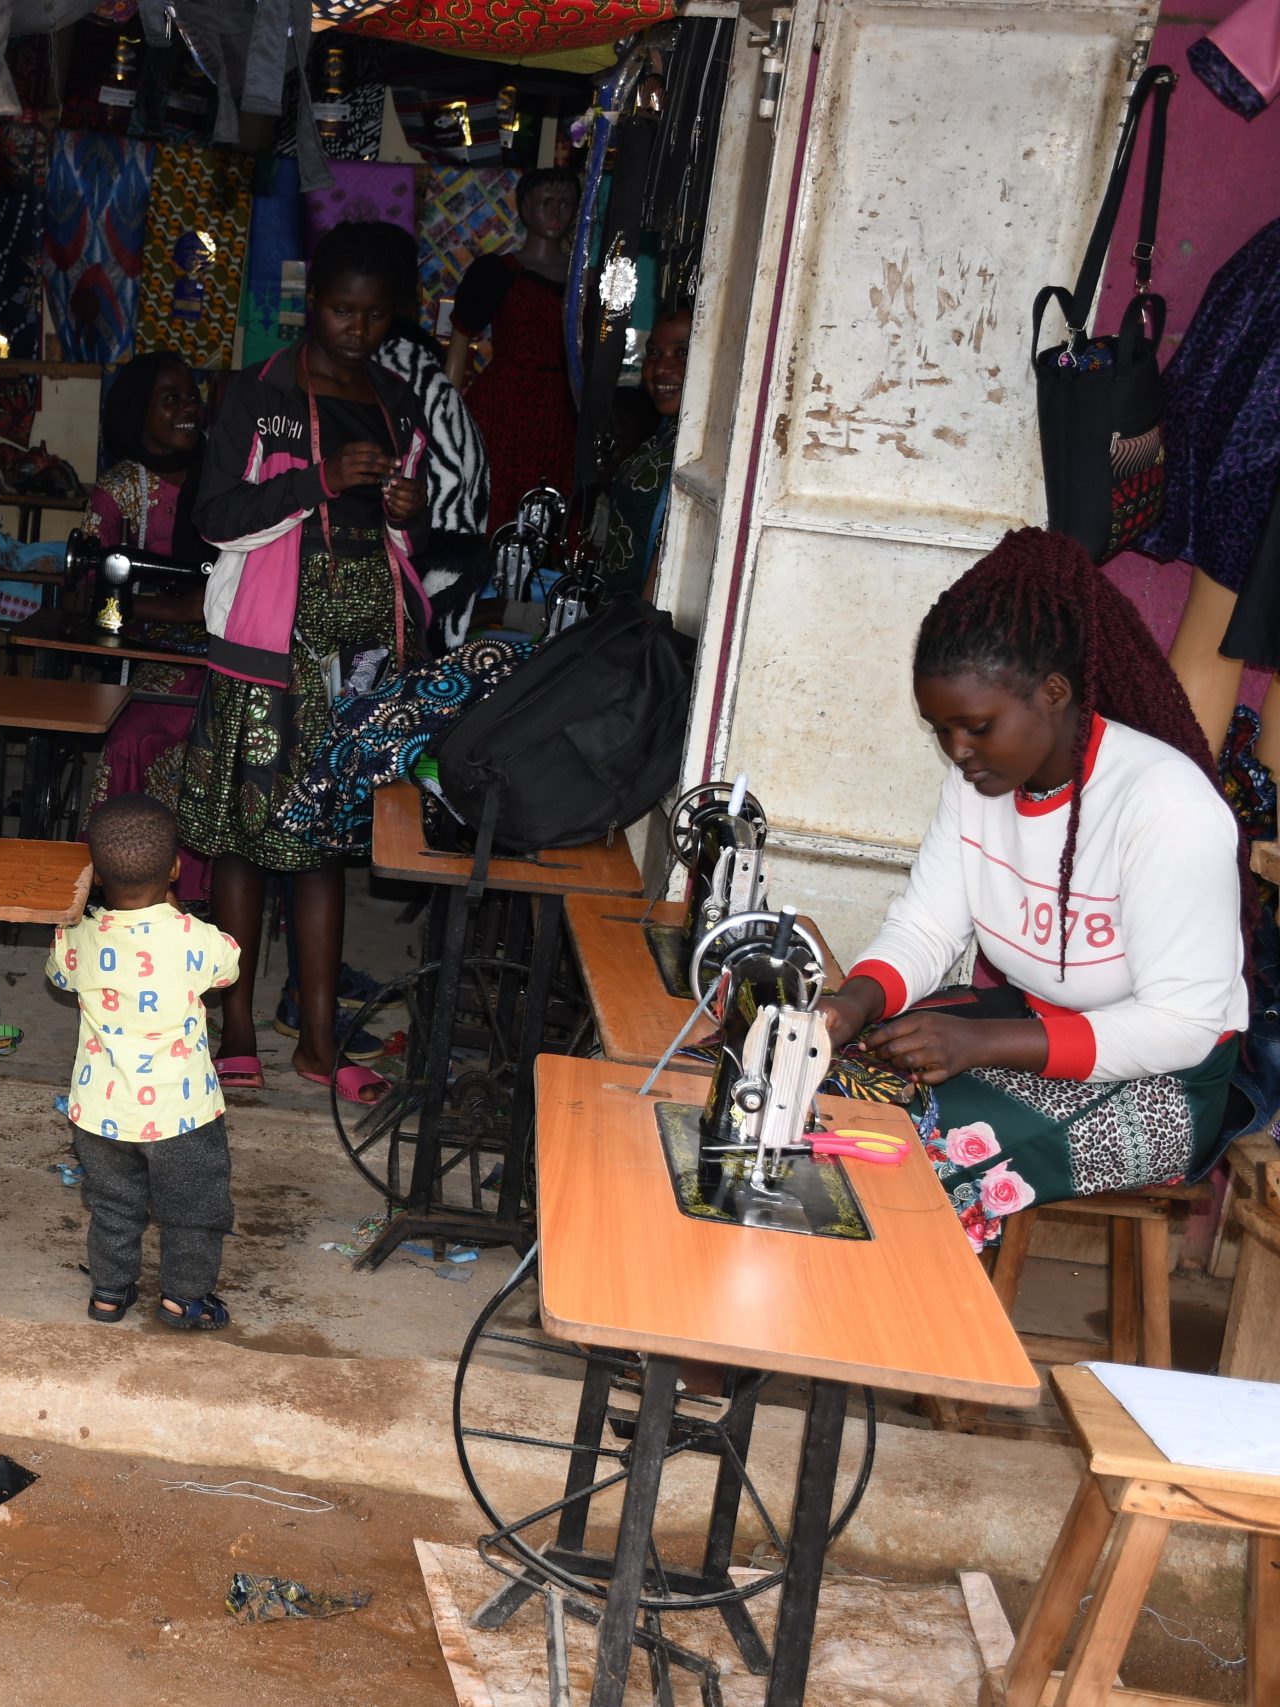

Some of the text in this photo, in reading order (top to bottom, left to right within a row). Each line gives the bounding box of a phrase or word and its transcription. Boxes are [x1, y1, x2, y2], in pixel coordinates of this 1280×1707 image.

[1019, 895, 1115, 948] 1978
[135, 951, 154, 978] 3
[186, 949, 204, 972] N
[101, 987, 120, 1012] 8
[139, 991, 158, 1013] R
[136, 1054, 153, 1073] Z
[140, 1121, 162, 1141] 4
